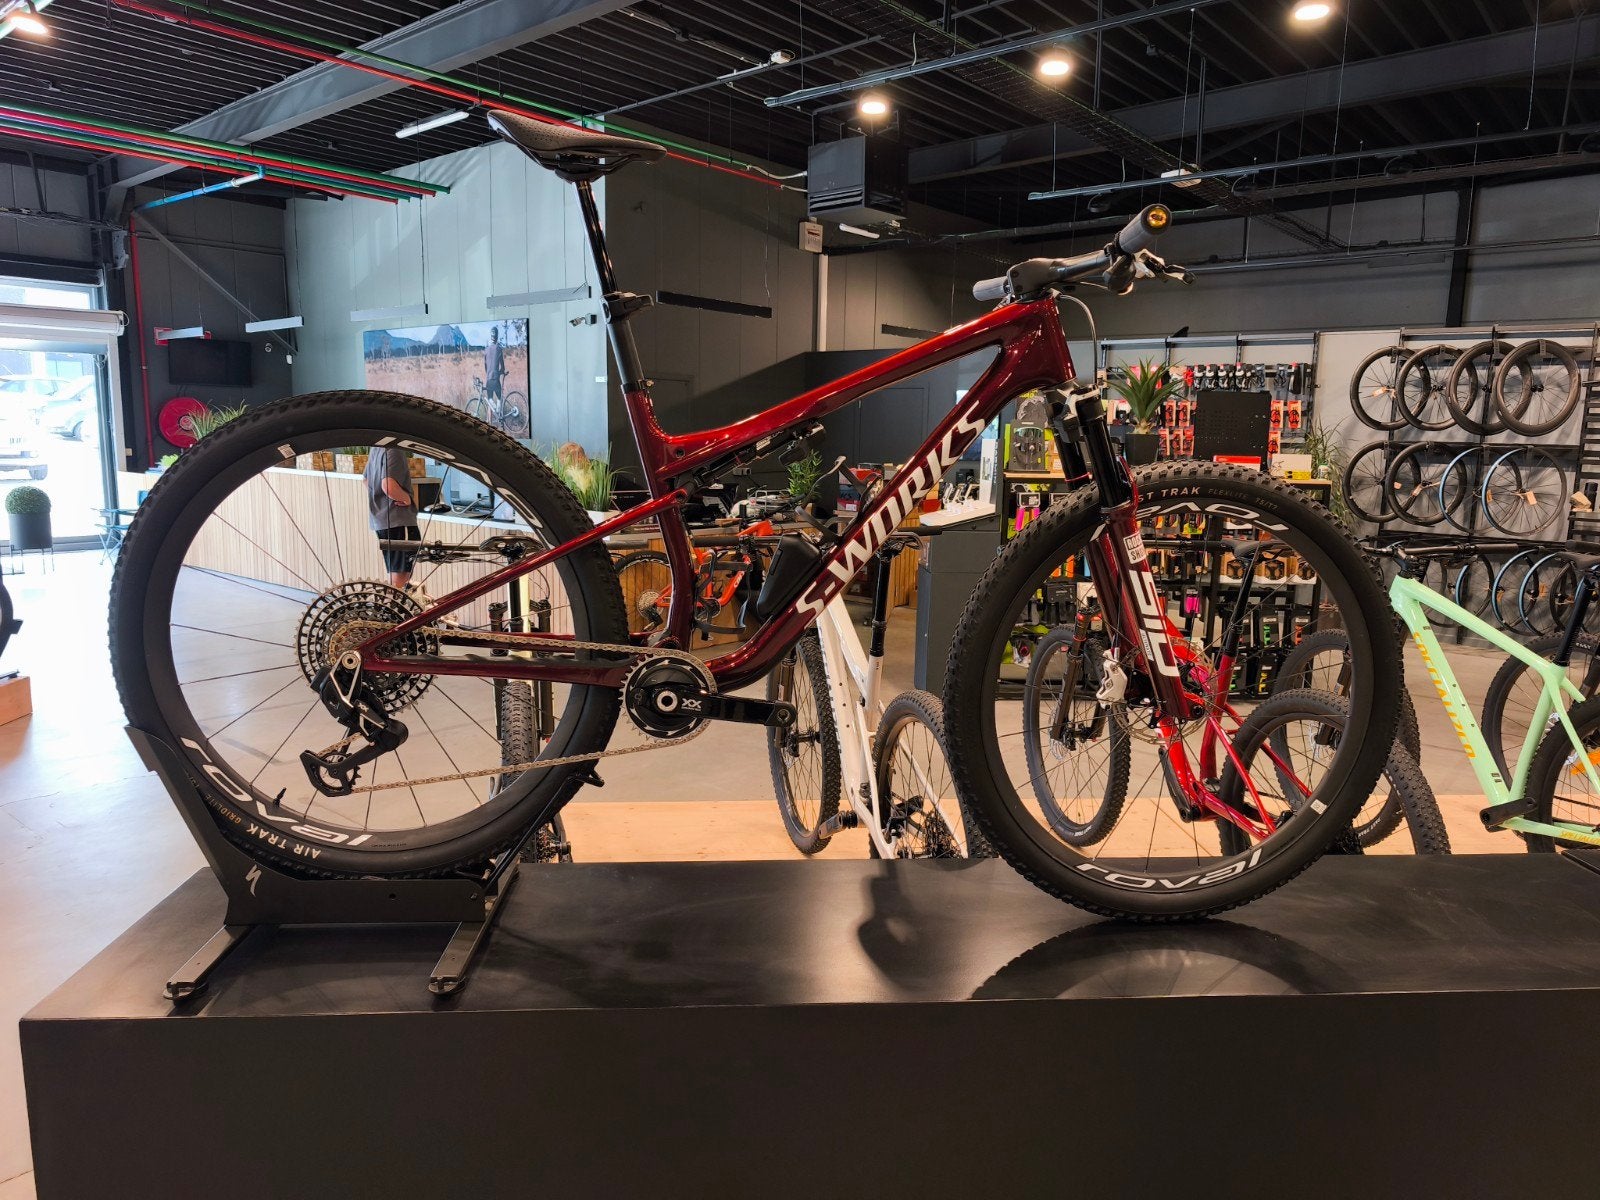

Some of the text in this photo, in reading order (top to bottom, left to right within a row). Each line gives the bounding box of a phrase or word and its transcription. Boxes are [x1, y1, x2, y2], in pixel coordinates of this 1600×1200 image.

[1162, 487, 1200, 497] TRAK
[795, 400, 985, 630] S-WORKS
[1128, 569, 1180, 677] SID
[682, 698, 702, 708] XX
[180, 737, 373, 846] roval
[204, 793, 242, 825] GRIDLITE
[246, 822, 288, 850] TRAK
[293, 846, 322, 859] AIR
[1076, 849, 1262, 889] roval
